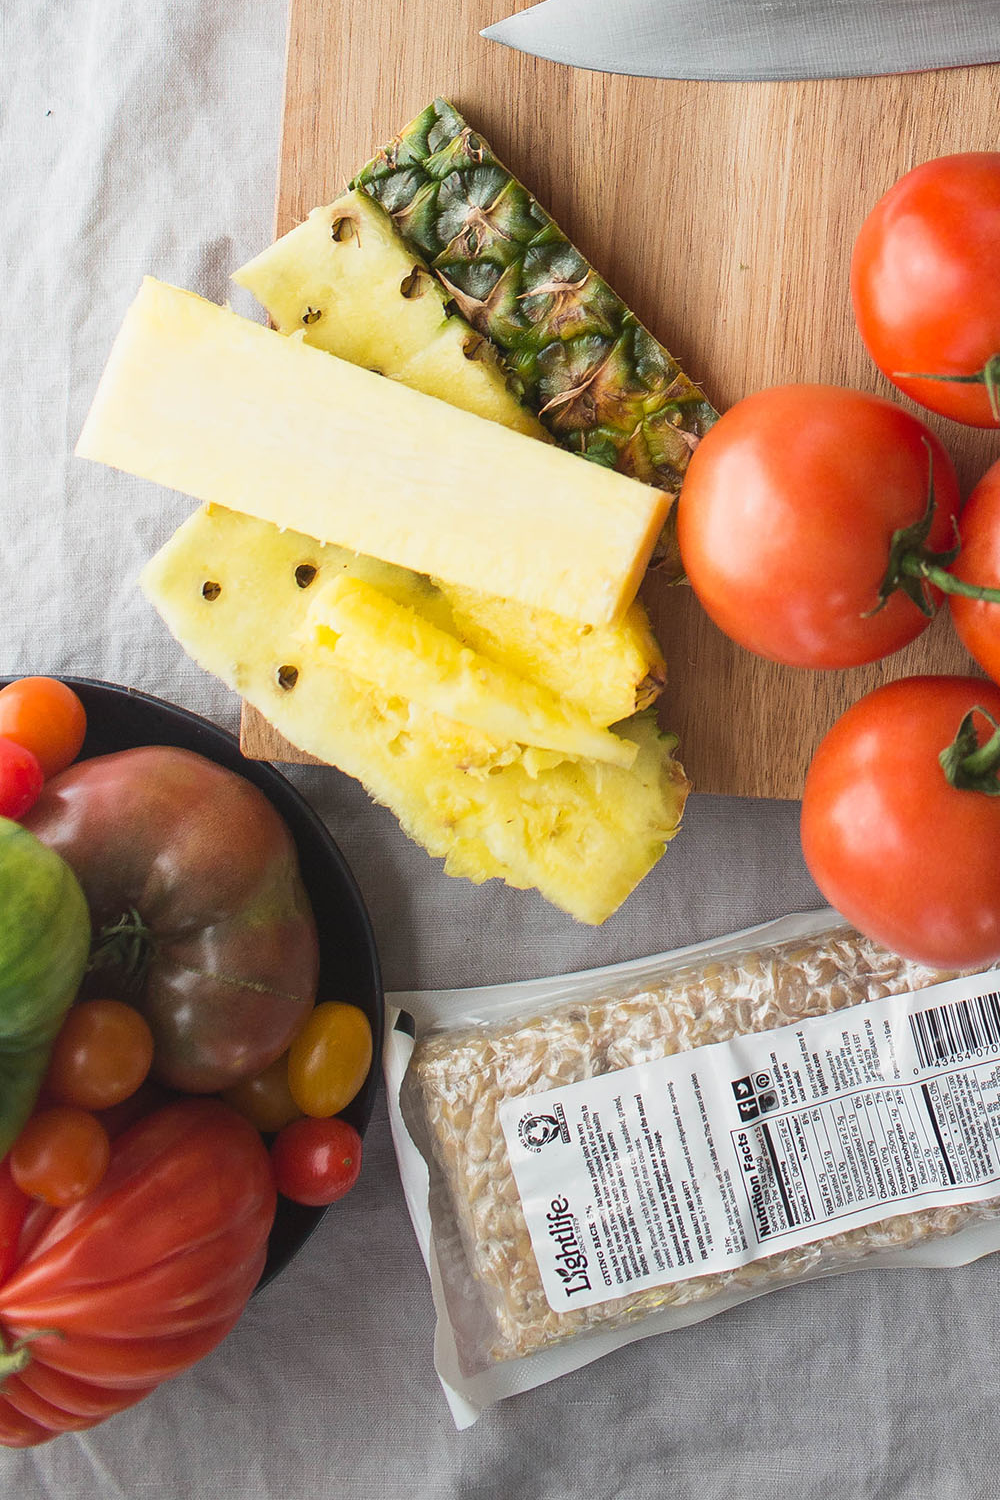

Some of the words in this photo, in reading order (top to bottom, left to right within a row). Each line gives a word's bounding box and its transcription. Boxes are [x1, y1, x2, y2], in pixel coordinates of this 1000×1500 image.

[934, 1051, 970, 1068] 43454
[884, 1090, 893, 1102] 5%
[928, 1082, 937, 1094] 0%
[634, 1094, 645, 1116] natural
[853, 1096, 862, 1109] 0%
[864, 1094, 873, 1106] 0%
[874, 1092, 883, 1104] 7%
[942, 1093, 952, 1110] 15%
[778, 1119, 785, 1127] 45
[800, 1112, 810, 1125] 8%
[811, 1109, 820, 1122] 5%
[837, 1115, 846, 1132] 2.5g
[848, 1114, 856, 1124] 1g
[889, 1108, 898, 1122] 14g
[935, 1103, 946, 1128] Vitamin
[948, 1110, 956, 1124] Iron
[518, 1117, 530, 1137] BACK
[559, 1122, 570, 1142] SINCE
[754, 1126, 762, 1138] 2.5
[780, 1127, 788, 1138] Fat
[850, 1124, 859, 1137] Fat
[906, 1131, 915, 1141] 6g
[644, 1135, 654, 1152] result
[654, 1130, 665, 1158] spoilage.
[758, 1138, 768, 1157] about
[784, 1138, 792, 1152] from
[798, 1136, 806, 1152] Daily
[841, 1132, 849, 1145] Fat
[886, 1130, 898, 1154] 250mg
[893, 1123, 913, 1172] Carbohydrate
[945, 1141, 954, 1154] 0%
[738, 1133, 755, 1172] Facts
[824, 1150, 831, 1160] 1g
[867, 1140, 876, 1156] 0mg
[880, 1147, 889, 1167] 10mg
[908, 1142, 921, 1160] Fiber
[924, 1148, 931, 1158] 0g
[956, 1143, 965, 1155] 6%
[661, 1159, 672, 1183] indicate
[755, 1156, 766, 1174] (84g)
[762, 1158, 776, 1188] Container
[780, 1161, 790, 1186] Serving
[788, 1153, 800, 1177] Calories
[826, 1161, 834, 1173] Fat
[838, 1161, 846, 1172] 0g
[844, 1146, 865, 1200] Polyunsaturated
[854, 1138, 875, 1197] Monounsaturated
[914, 1160, 928, 1184] Dietary
[927, 1159, 938, 1183] Sugars
[937, 1160, 949, 1186] Protein
[952, 1160, 963, 1184] Vitamin
[960, 1156, 973, 1183] Calcium
[653, 1170, 664, 1193] tempeh
[760, 1174, 767, 1184] oz
[818, 1173, 826, 1183] 5g
[840, 1172, 849, 1184] Fat
[870, 1157, 887, 1199] Cholesterol
[886, 1168, 898, 1196] Sodium
[894, 1155, 908, 1194] Potassium
[908, 1174, 918, 1192] Total
[666, 1183, 674, 1194] not
[763, 1189, 772, 1204] Size
[795, 1181, 804, 1194] 170
[821, 1183, 829, 1197] Fat
[829, 1174, 844, 1207] Saturated
[845, 1184, 854, 1204] Trans
[663, 1201, 672, 1218] areas
[671, 1203, 680, 1214] and
[750, 1176, 771, 1236] Nutrition
[790, 1200, 801, 1225] Amount
[800, 1194, 812, 1222] Calories
[824, 1197, 834, 1216] Total
[767, 1205, 779, 1232] Serving
[775, 1201, 787, 1230] Servings
[572, 1217, 581, 1234] 1979
[666, 1219, 676, 1232] dark
[676, 1215, 688, 1239] process
[589, 1222, 601, 1248] BACK
[547, 1199, 591, 1296] Lightlife
[576, 1235, 587, 1254] SINCE
[670, 1233, 685, 1266] Occasional
[682, 1239, 694, 1264] coloring
[597, 1251, 612, 1286] GIVING
